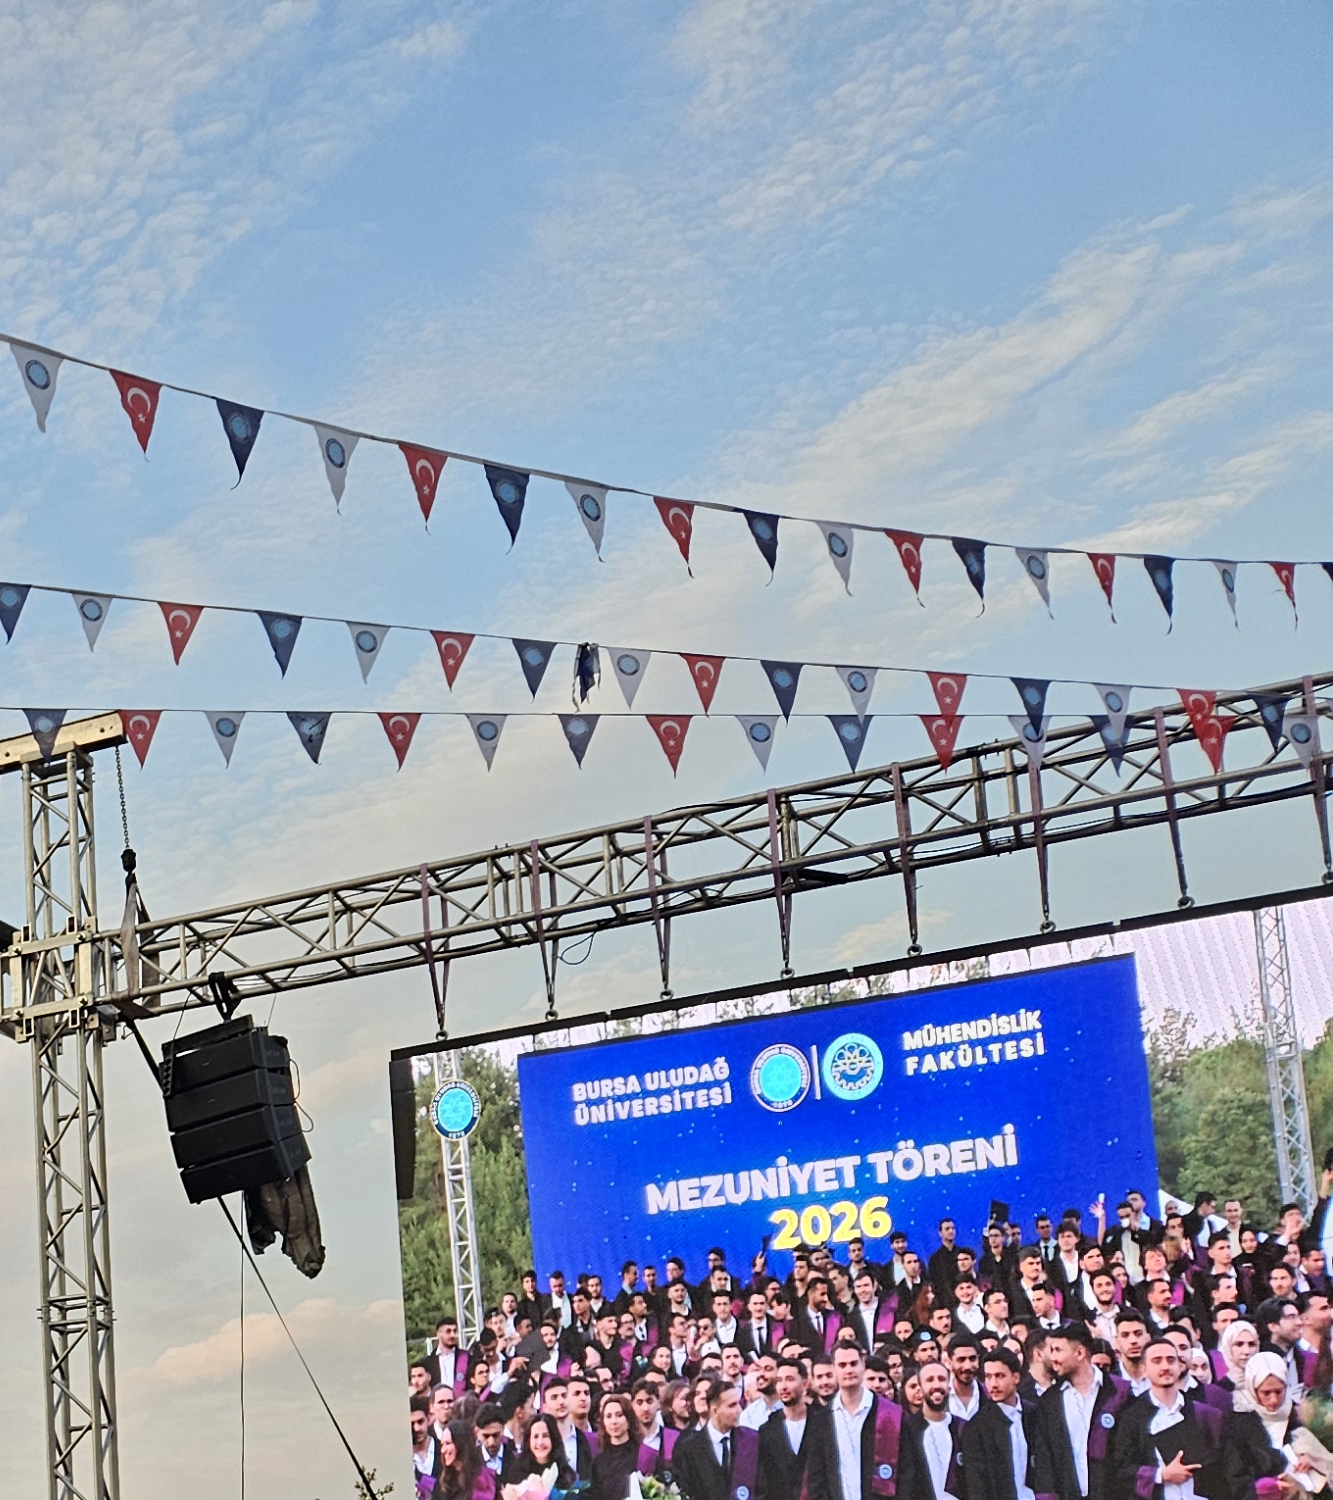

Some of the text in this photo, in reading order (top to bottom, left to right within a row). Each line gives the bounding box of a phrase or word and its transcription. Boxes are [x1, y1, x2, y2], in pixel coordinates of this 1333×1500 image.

[903, 1008, 1042, 1050] MÜHENDİSLİK
[906, 1032, 1045, 1076] FAKÜLTESİ
[572, 1075, 641, 1102] BURSA
[644, 1057, 730, 1091] ULUDAĞ
[574, 1082, 732, 1126] ÜNİVERSİTESİ
[644, 1123, 1018, 1214] MEZUNİYET TÖRENİ
[769, 1197, 892, 1250] 2026
